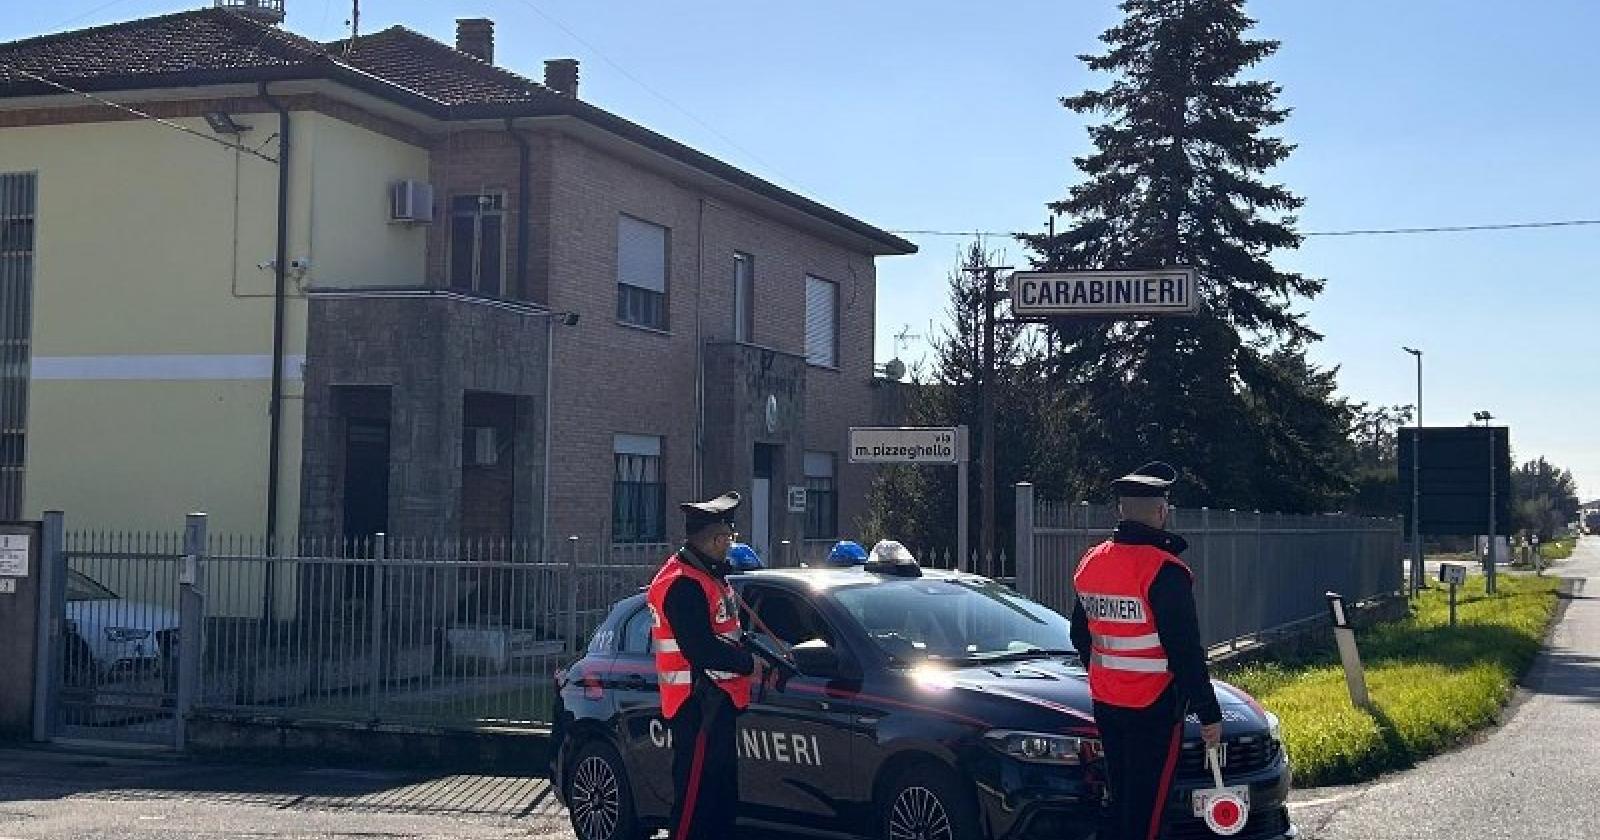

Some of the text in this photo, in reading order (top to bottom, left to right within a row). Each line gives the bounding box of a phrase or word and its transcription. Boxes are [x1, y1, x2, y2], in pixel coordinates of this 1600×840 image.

[1022, 278, 1183, 305] CARABINIERI
[935, 432, 951, 443] via
[649, 718, 822, 766] CNIERI
